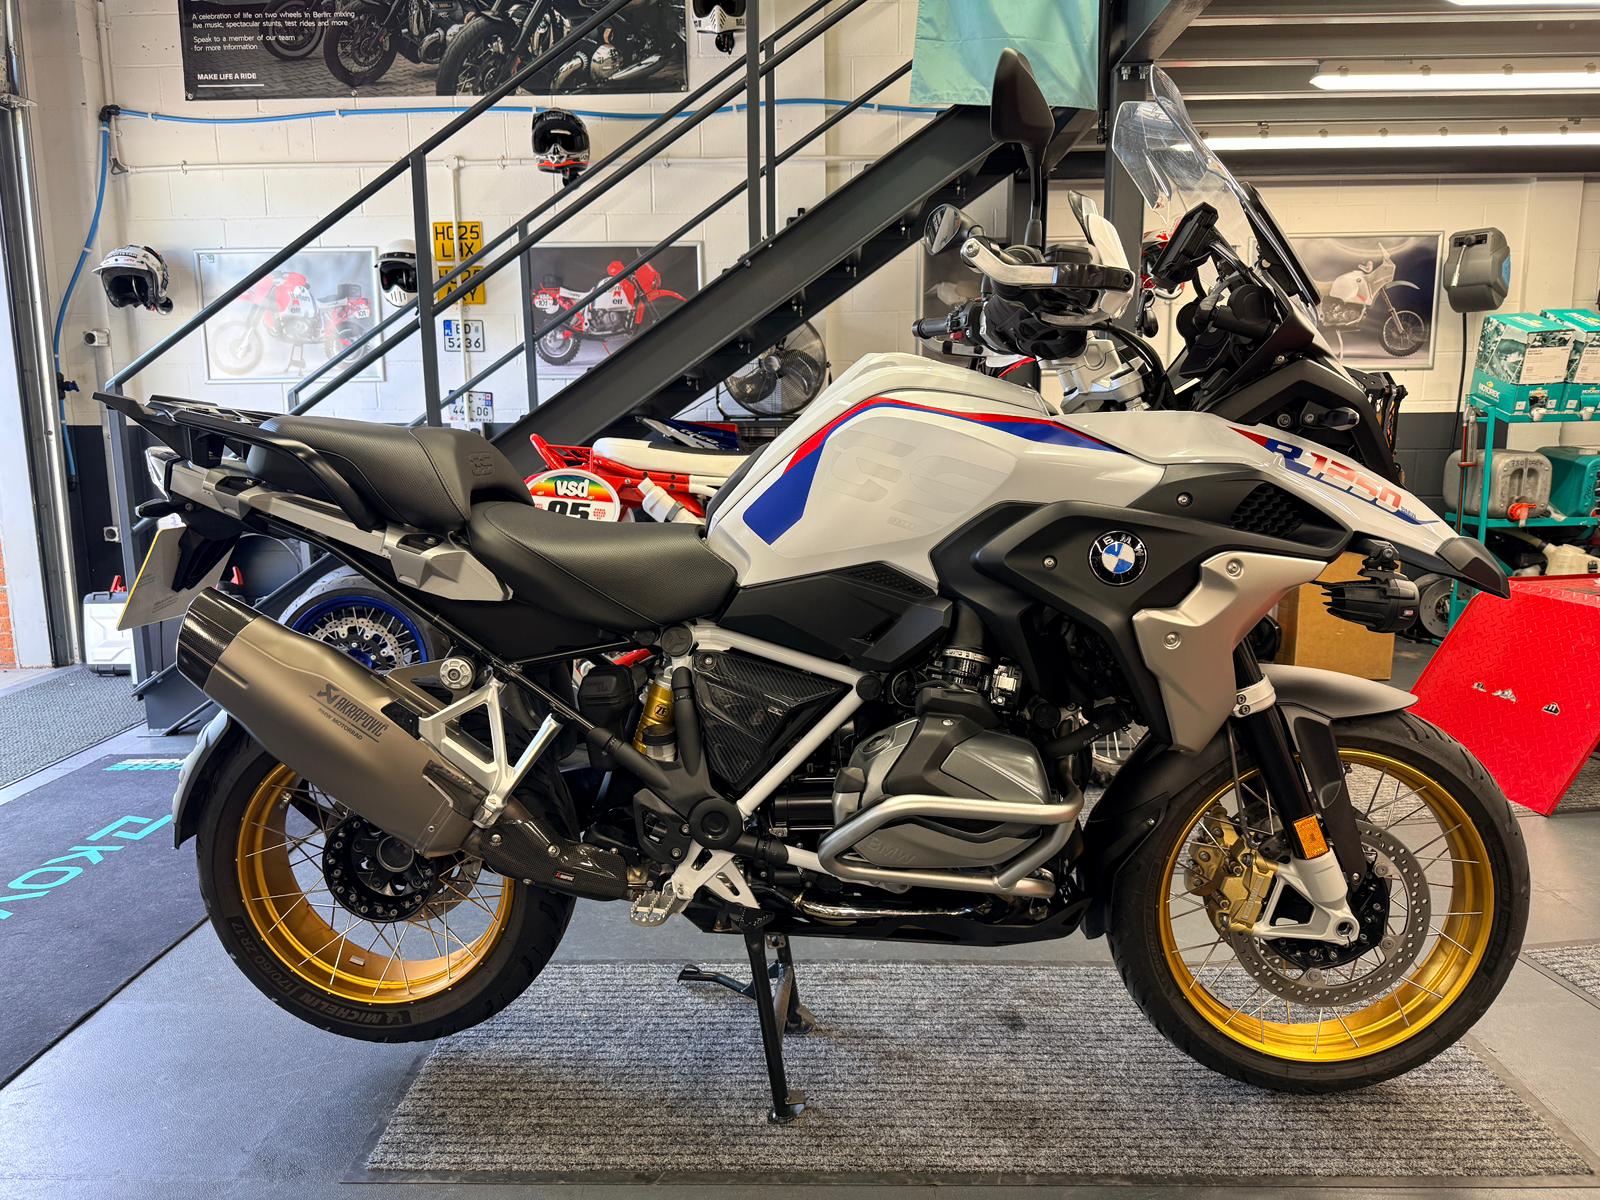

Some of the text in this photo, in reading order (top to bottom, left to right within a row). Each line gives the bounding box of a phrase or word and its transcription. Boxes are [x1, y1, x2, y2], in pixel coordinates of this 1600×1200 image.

[199, 12, 231, 20] celebration
[334, 10, 355, 19] mixing
[193, 35, 212, 44] Speak
[229, 34, 254, 42] member
[194, 44, 203, 52] for
[223, 43, 258, 51] information
[240, 72, 257, 80] RIDE
[555, 478, 590, 498] vsd
[1102, 534, 1145, 556] BMW
[253, 955, 294, 996] 170/60
[298, 990, 384, 1026] MICHELIN
